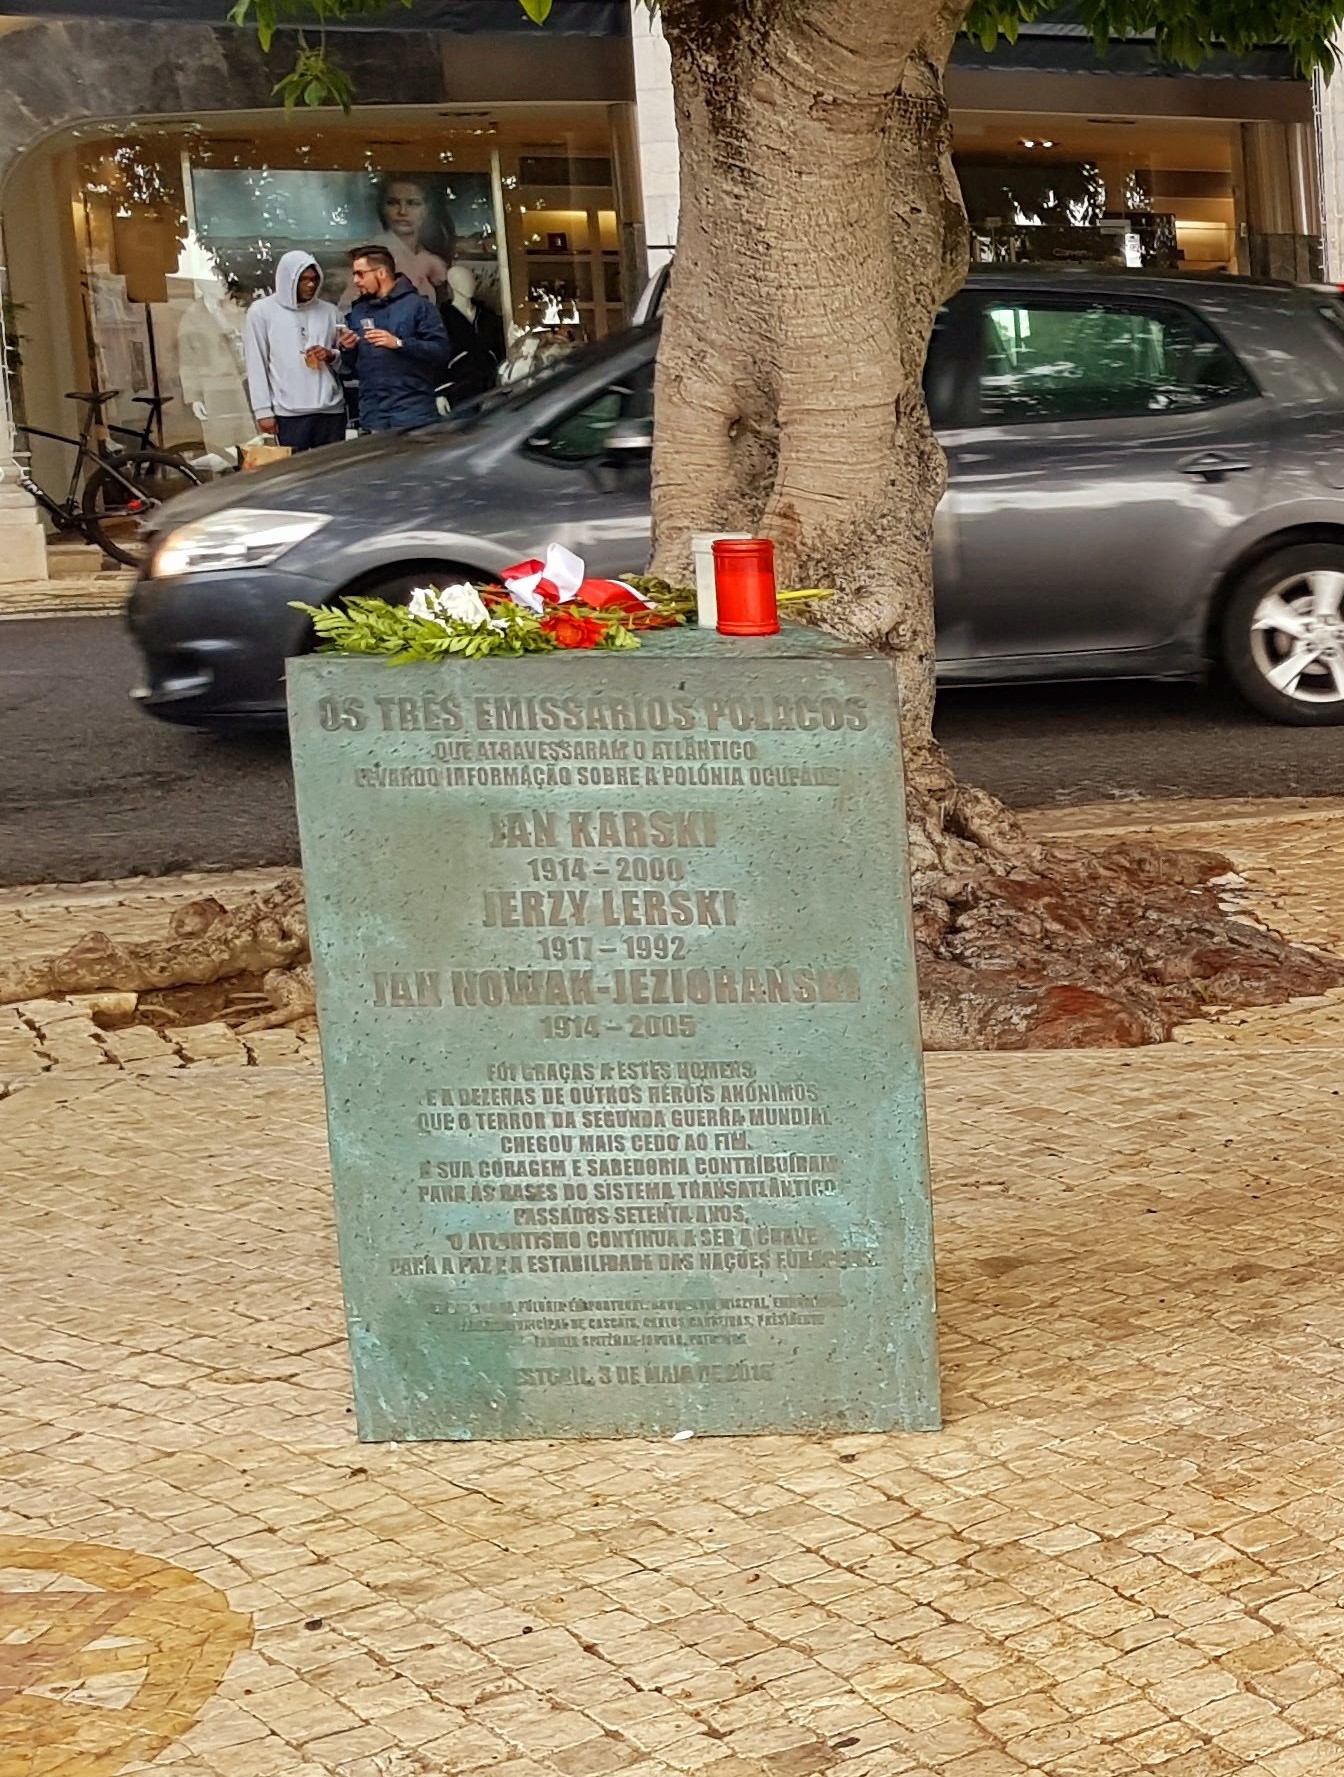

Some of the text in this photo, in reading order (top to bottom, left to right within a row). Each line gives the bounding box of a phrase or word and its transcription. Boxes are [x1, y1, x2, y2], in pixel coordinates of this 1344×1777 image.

[319, 696, 367, 732] OS
[706, 695, 869, 732] POLACOS
[434, 736, 757, 762] QUE ATRAVESSARAM O ATLÂNTICO
[355, 766, 439, 788] LEVANDO
[446, 763, 572, 790] INFORMAÇÃO
[577, 765, 640, 787] SOBRE
[645, 766, 660, 787] A
[663, 763, 745, 786] POLÓNIA
[489, 811, 718, 849] JAN KARSKI
[526, 857, 587, 882] 1914
[616, 857, 686, 881] 2000
[482, 889, 737, 928] JERZY LERSKI
[537, 936, 593, 961] 1917
[624, 935, 687, 960] 1992
[373, 970, 443, 1007] JAN
[539, 1014, 599, 1040] 1914
[628, 1013, 697, 1039] 2005
[522, 1062, 595, 1084] GRAÇAS
[600, 1062, 614, 1081] A
[617, 1060, 671, 1081] ESTES
[426, 1082, 819, 1107] E A DEZENAS DE OUTROS HERÓIS ANÓNIMOS
[417, 1107, 833, 1132] QUE O TERROR DA SEGUNDA GUERRA MUNDIAL
[500, 1134, 573, 1154] CHEGOU
[579, 1133, 626, 1153] MAIS
[630, 1133, 679, 1152] CEDO
[684, 1132, 709, 1151] AO
[436, 1160, 474, 1179] SUA
[478, 1159, 566, 1179] CORAGEM
[572, 1158, 583, 1177] E
[586, 1158, 689, 1177] SABEDORIA
[418, 1184, 466, 1203] PARA
[471, 1184, 496, 1202] AS
[499, 1183, 558, 1202] BASES
[563, 1183, 588, 1201] DO
[593, 1181, 675, 1201] SISTEMA
[513, 1206, 609, 1226] PASSADOS
[614, 1204, 692, 1225] SETENTA
[468, 1230, 581, 1250] ATLANTISMO
[586, 1228, 679, 1249] CONTINUA
[682, 1228, 697, 1248] A
[700, 1227, 735, 1247] SER
[739, 1227, 755, 1246] A
[441, 1256, 455, 1275] A
[658, 1252, 694, 1272] DAS
[699, 1249, 771, 1273] NAÇÕES
[616, 1365, 640, 1385] DE
